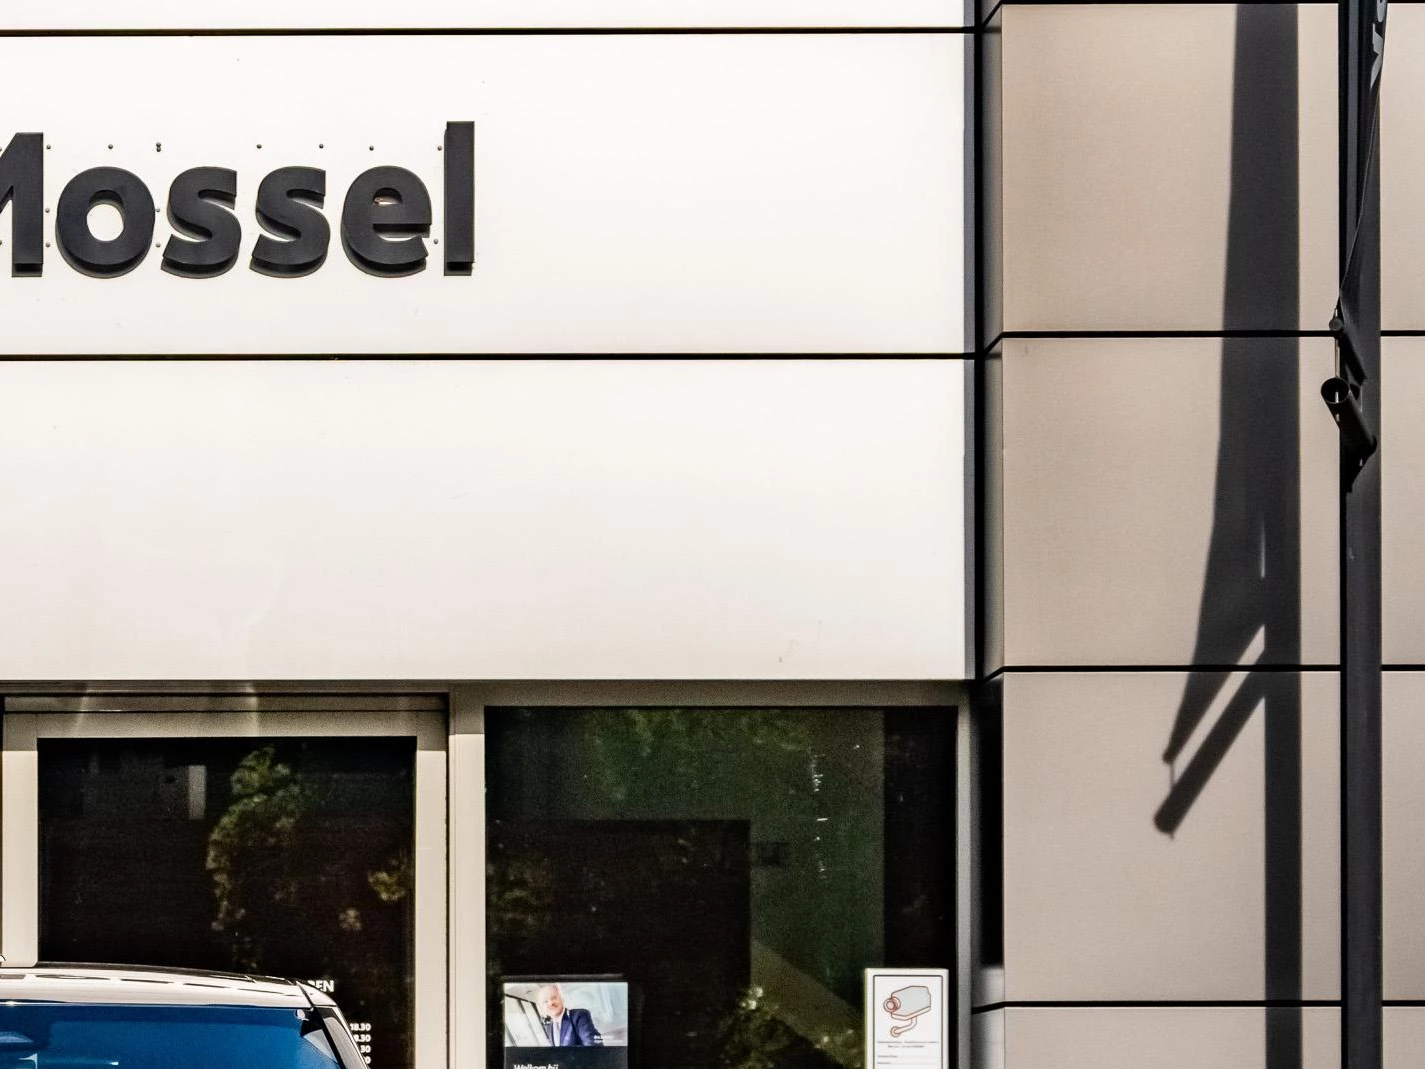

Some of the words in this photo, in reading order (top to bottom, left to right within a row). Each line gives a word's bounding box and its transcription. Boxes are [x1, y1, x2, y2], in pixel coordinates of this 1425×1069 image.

[308, 980, 334, 992] EN
[350, 1023, 371, 1031] 18.30
[353, 1034, 371, 1042] 8.30
[360, 1045, 371, 1053] 30
